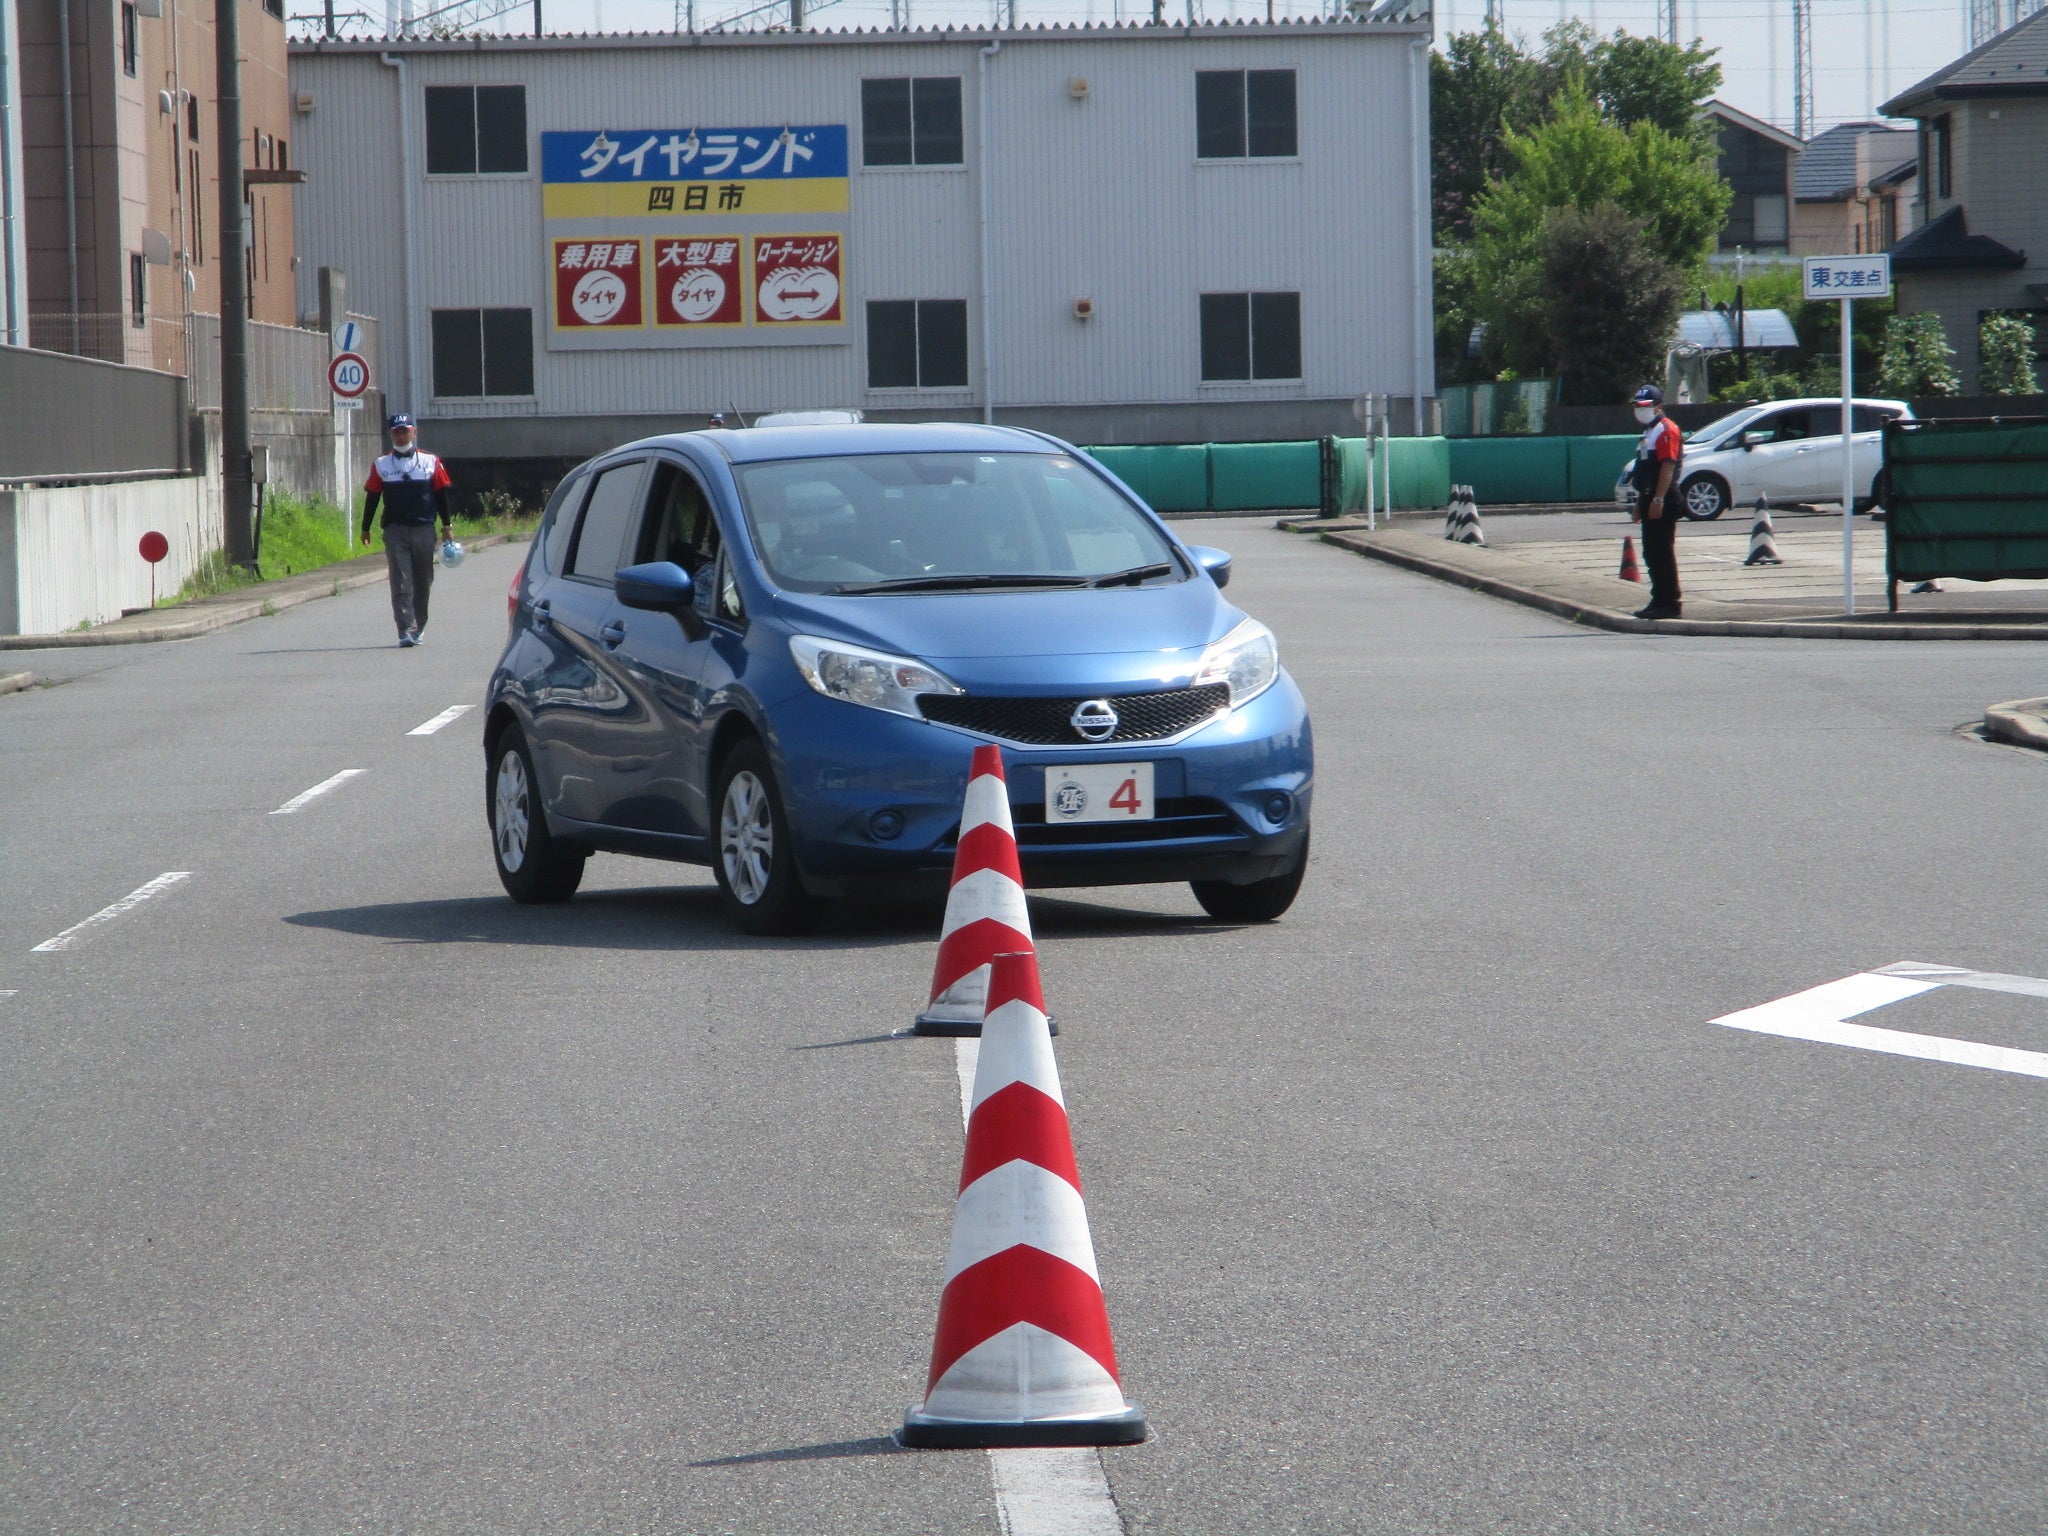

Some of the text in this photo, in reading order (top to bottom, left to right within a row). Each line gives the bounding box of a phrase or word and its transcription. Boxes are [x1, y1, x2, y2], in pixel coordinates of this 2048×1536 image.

[580, 132, 815, 178] タイヤランド
[648, 184, 745, 211] 四日市
[559, 243, 637, 268] 乗用車
[658, 241, 737, 266] 大型車
[757, 240, 838, 264] ローテーション
[578, 290, 617, 304] タイヤ
[678, 288, 716, 302] タイヤ
[338, 365, 361, 385] 40
[1077, 716, 1114, 725] NISSAN
[1109, 778, 1141, 814] 4
